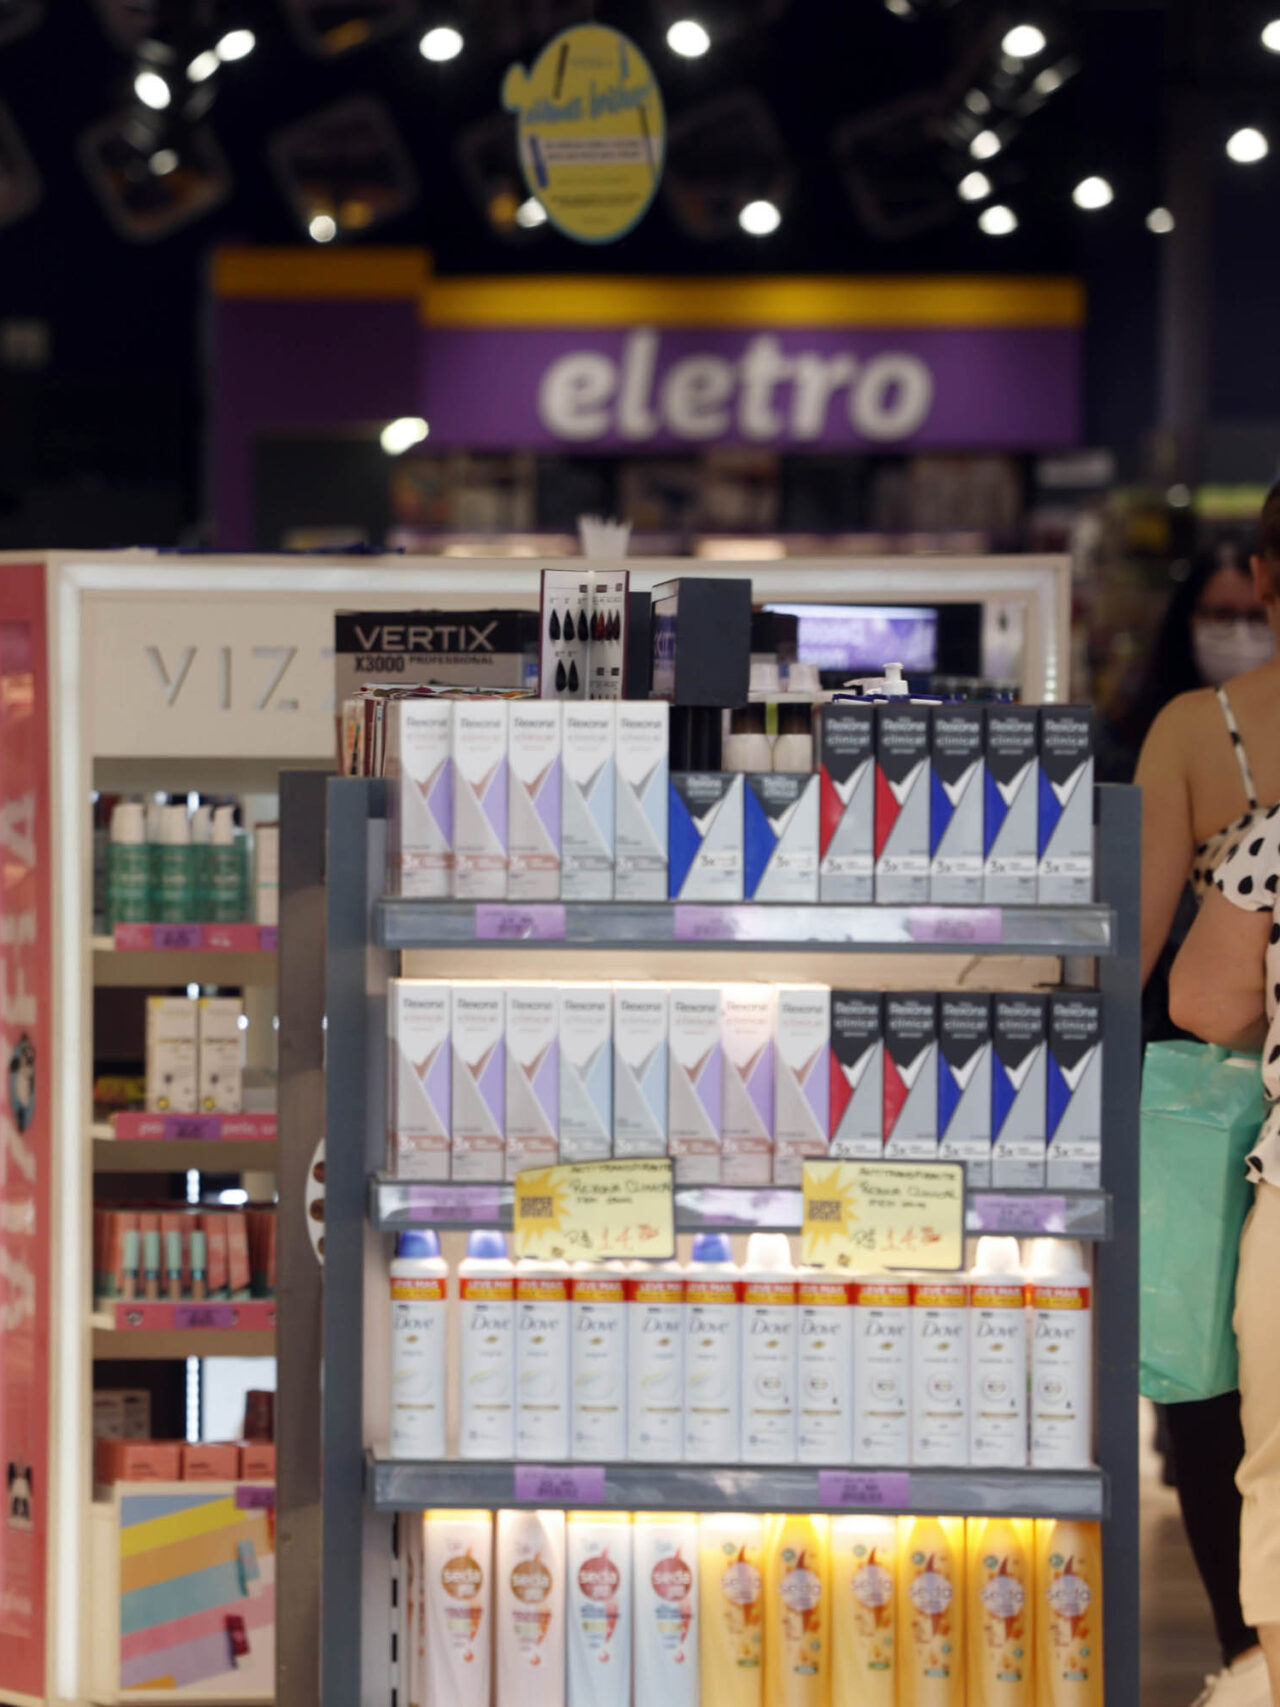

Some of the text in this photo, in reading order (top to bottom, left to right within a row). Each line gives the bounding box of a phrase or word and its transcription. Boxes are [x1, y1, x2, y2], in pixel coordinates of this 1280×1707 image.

[538, 326, 934, 442] eletro
[354, 621, 498, 651] VERTIX
[354, 655, 405, 673] X3000
[409, 655, 494, 666] PROFESSIONAL
[146, 646, 334, 711] VIZ
[825, 718, 869, 732] Rexona
[881, 718, 926, 732] Rexona
[936, 719, 980, 733] Rexona
[990, 719, 1034, 733] Rexona
[1045, 719, 1089, 734] Rexona
[825, 734, 869, 746] clinical
[881, 734, 926, 746] clinical
[936, 735, 980, 747] clinical
[990, 735, 1034, 747] clinical
[1045, 735, 1089, 747] clinical
[833, 1001, 878, 1016] Rexona
[888, 1001, 933, 1016] Rexona
[943, 1002, 988, 1017] Rexona
[997, 1002, 1042, 1017] Rexona
[1053, 1003, 1098, 1018] Rexona
[833, 1018, 878, 1030] clinical
[888, 1018, 933, 1030] clinical
[943, 1019, 988, 1031] clinical
[997, 1019, 1042, 1031] clinical
[1053, 1020, 1098, 1032] clinical
[393, 1315, 434, 1332] Dove
[470, 1315, 510, 1332] Dove
[519, 1316, 559, 1332] Dove
[576, 1316, 617, 1333] Dove
[641, 1317, 681, 1334] Dove
[688, 1317, 728, 1334] Dove
[750, 1318, 791, 1335] Dove
[800, 1319, 841, 1336] Dove
[864, 1321, 905, 1338] Dove
[921, 1321, 963, 1338] Dove
[976, 1322, 1018, 1339] Dove
[1034, 1324, 1075, 1340] Dove
